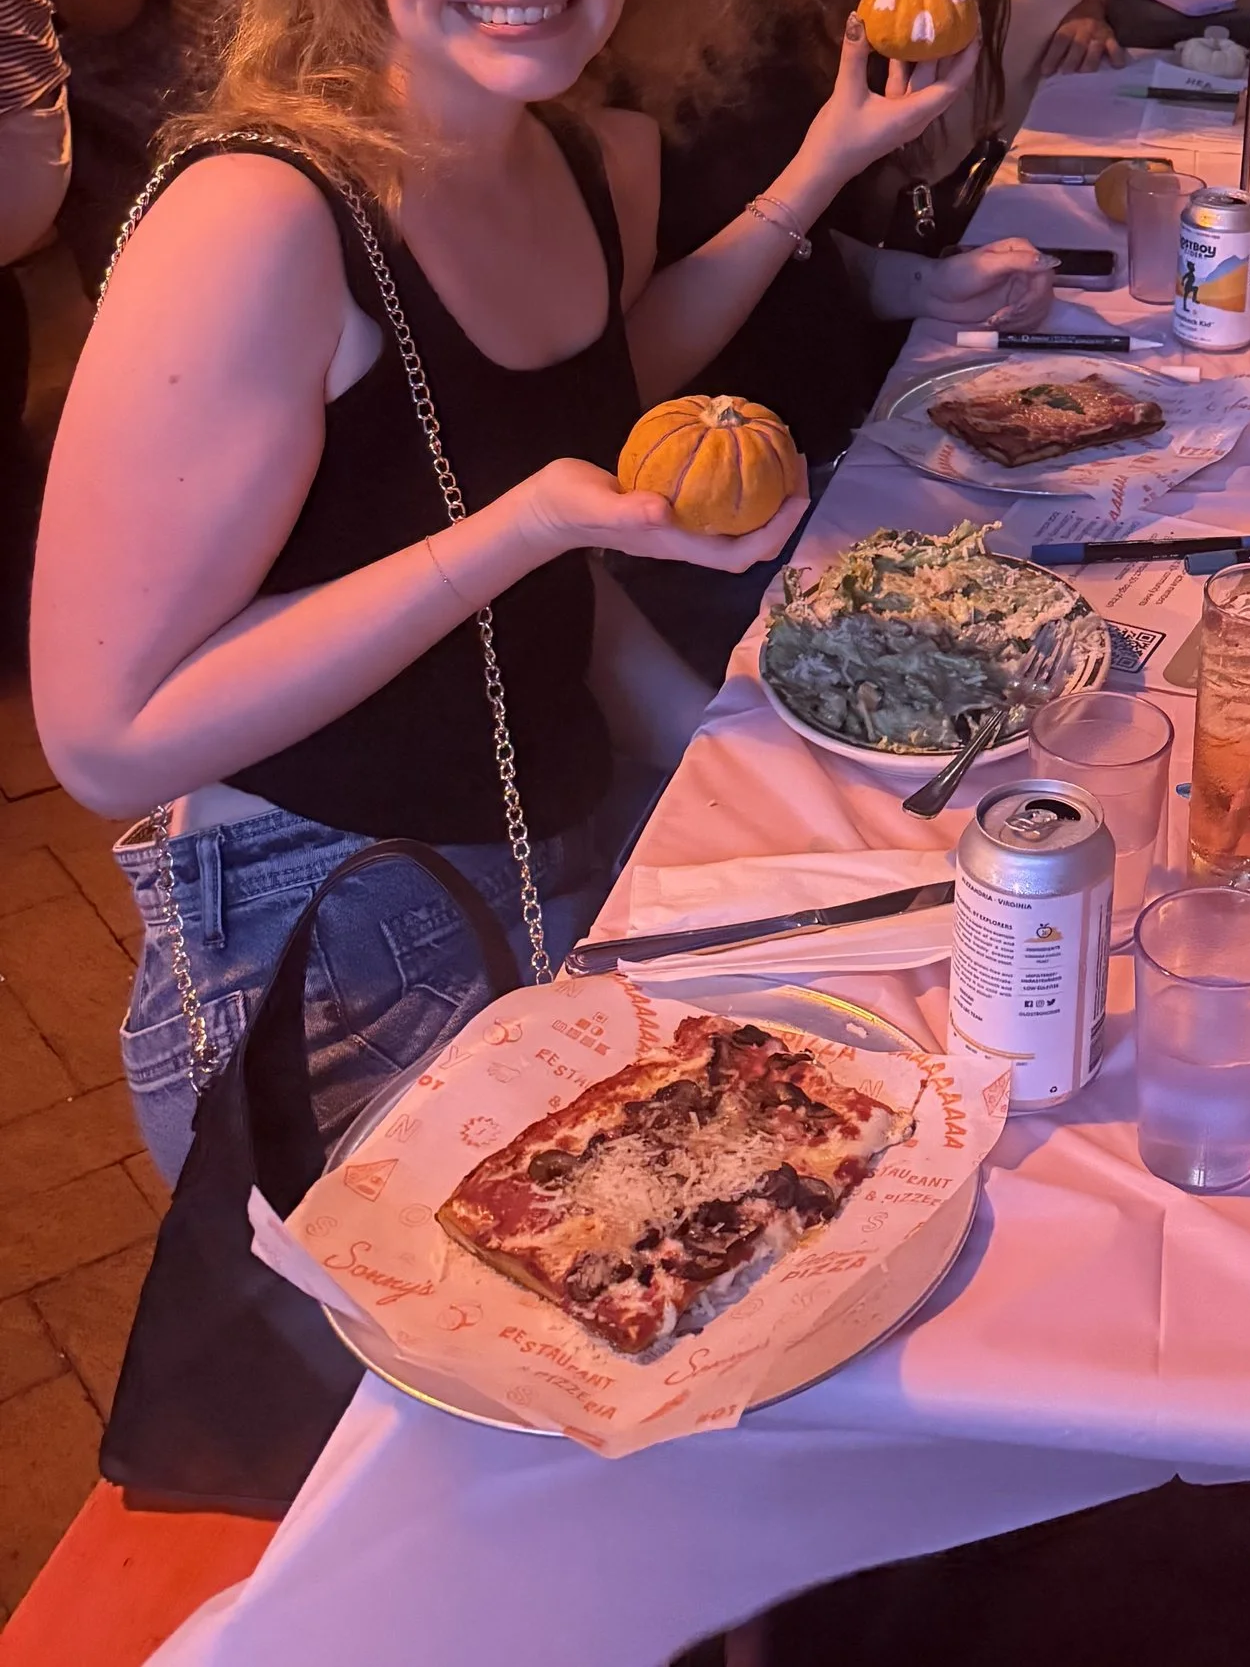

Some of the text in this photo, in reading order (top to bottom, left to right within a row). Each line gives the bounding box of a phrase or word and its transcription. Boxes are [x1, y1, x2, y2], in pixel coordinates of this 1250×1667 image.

[998, 898, 1032, 910] VIRGINIA
[979, 913, 1012, 930] EXPLORERS
[324, 1242, 436, 1305] Sonny's
[780, 1256, 867, 1283] PIZZA
[499, 1325, 616, 1392] RESTAURANT
